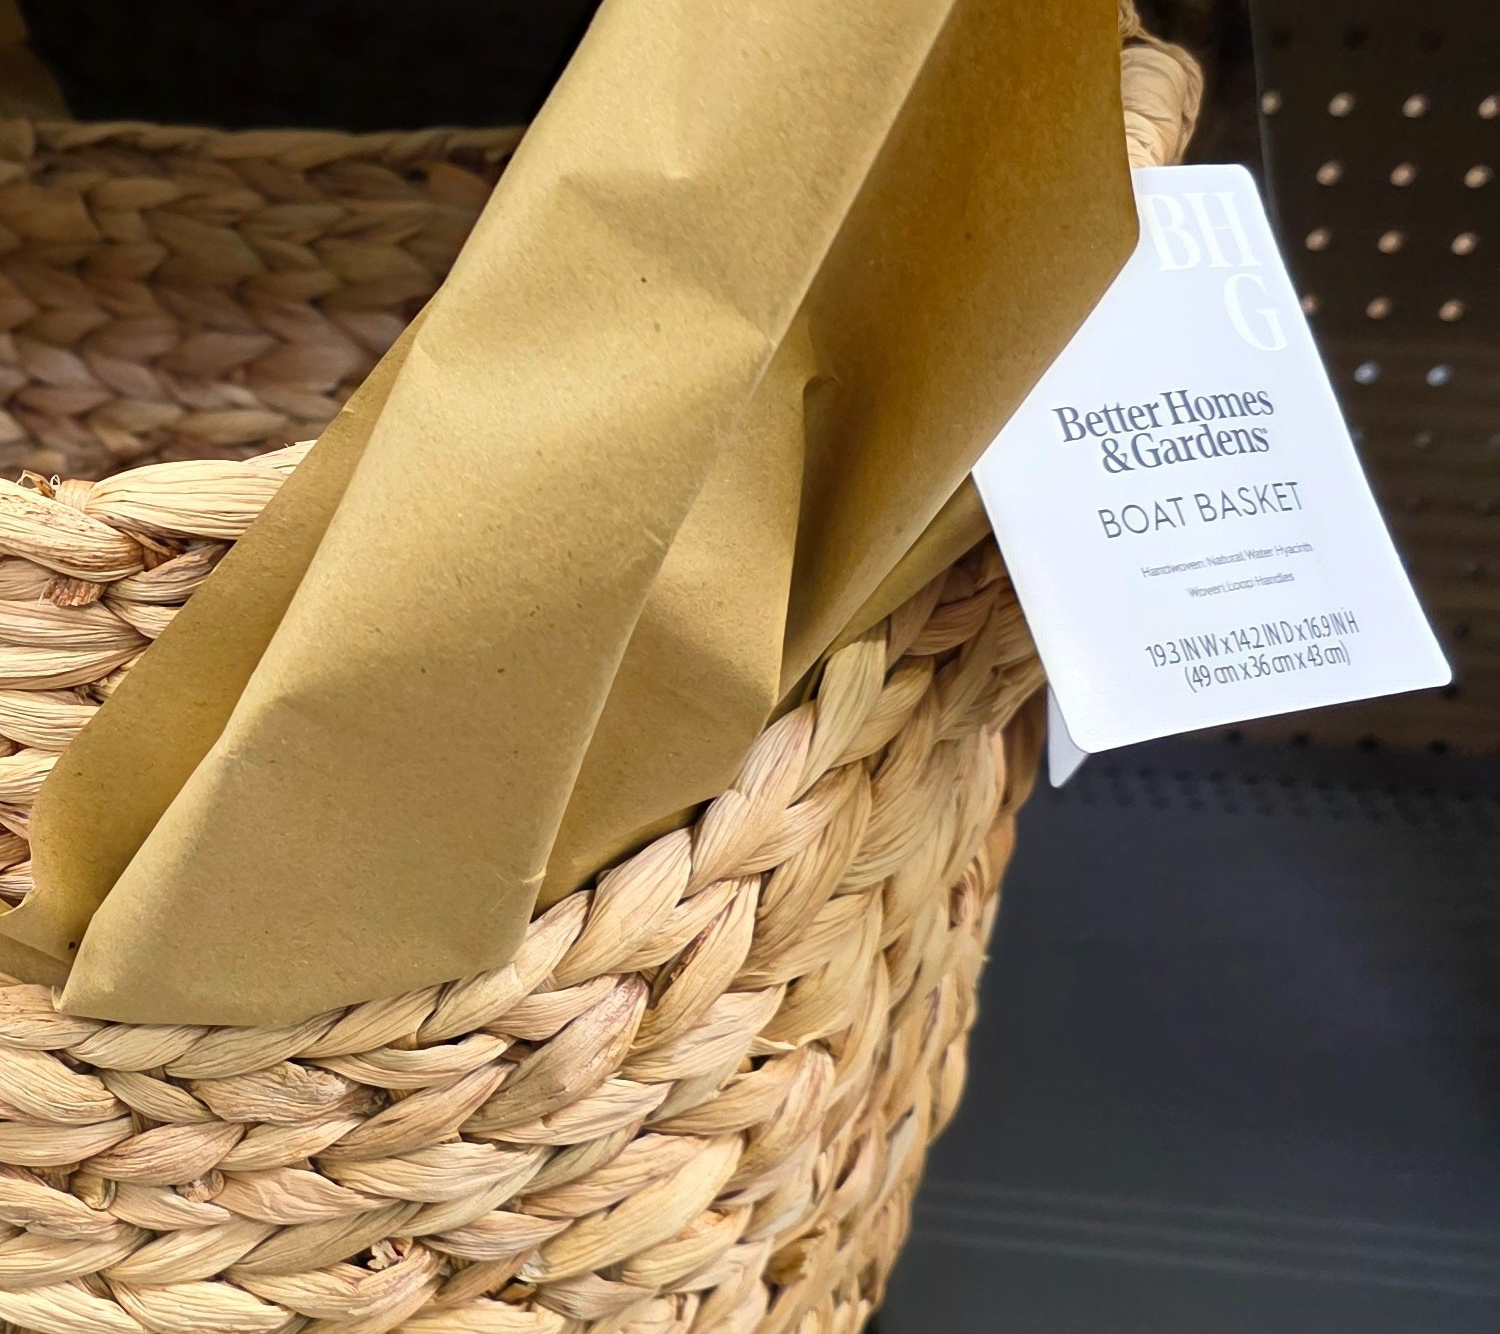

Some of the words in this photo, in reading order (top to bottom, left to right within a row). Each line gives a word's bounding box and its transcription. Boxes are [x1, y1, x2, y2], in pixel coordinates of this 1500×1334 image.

[1140, 191, 1262, 271] BH
[1224, 273, 1287, 351] G
[1052, 401, 1162, 443] Better
[1160, 389, 1275, 426] Homes
[1130, 424, 1270, 468] Gardens
[1098, 496, 1186, 538] BOAT
[1193, 481, 1303, 522] BASKET
[1246, 546, 1274, 560] Water
[1187, 582, 1225, 598] Woven
[1184, 664, 1211, 693] (49
[1214, 665, 1240, 684] cm
[1237, 662, 1253, 680] x
[1248, 654, 1271, 677] 36
[1272, 654, 1296, 674] cm
[1293, 652, 1308, 669] x
[1306, 644, 1324, 667] 43
[1324, 640, 1351, 666] cm)
[1197, 633, 1219, 658] W
[1219, 637, 1234, 655] x
